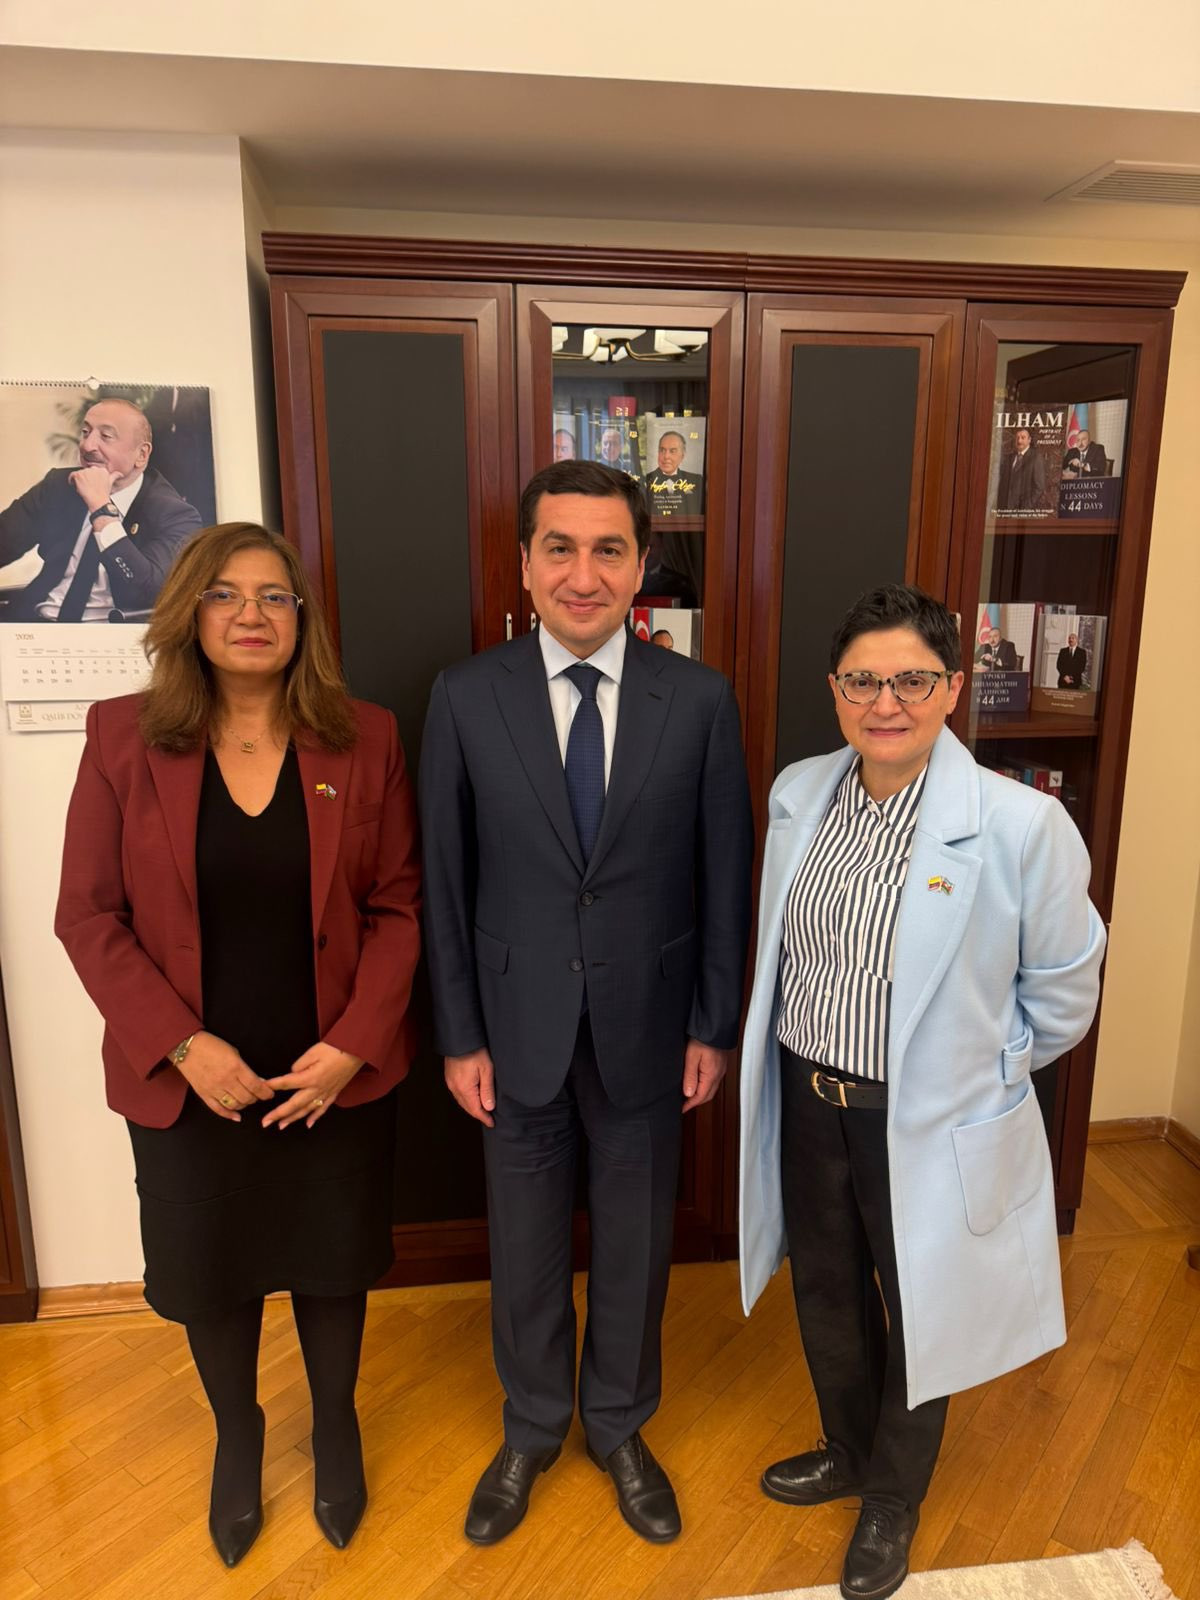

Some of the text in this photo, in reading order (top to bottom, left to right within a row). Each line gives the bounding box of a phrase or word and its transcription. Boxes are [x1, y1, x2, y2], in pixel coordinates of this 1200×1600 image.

[996, 412, 1064, 428] ILHAM
[1060, 482, 1105, 490] DIPLOMACY
[1064, 492, 1098, 500] LESSONS
[1068, 500, 1082, 512] 44
[1083, 502, 1104, 510] DAYS
[982, 695, 995, 705] 44
